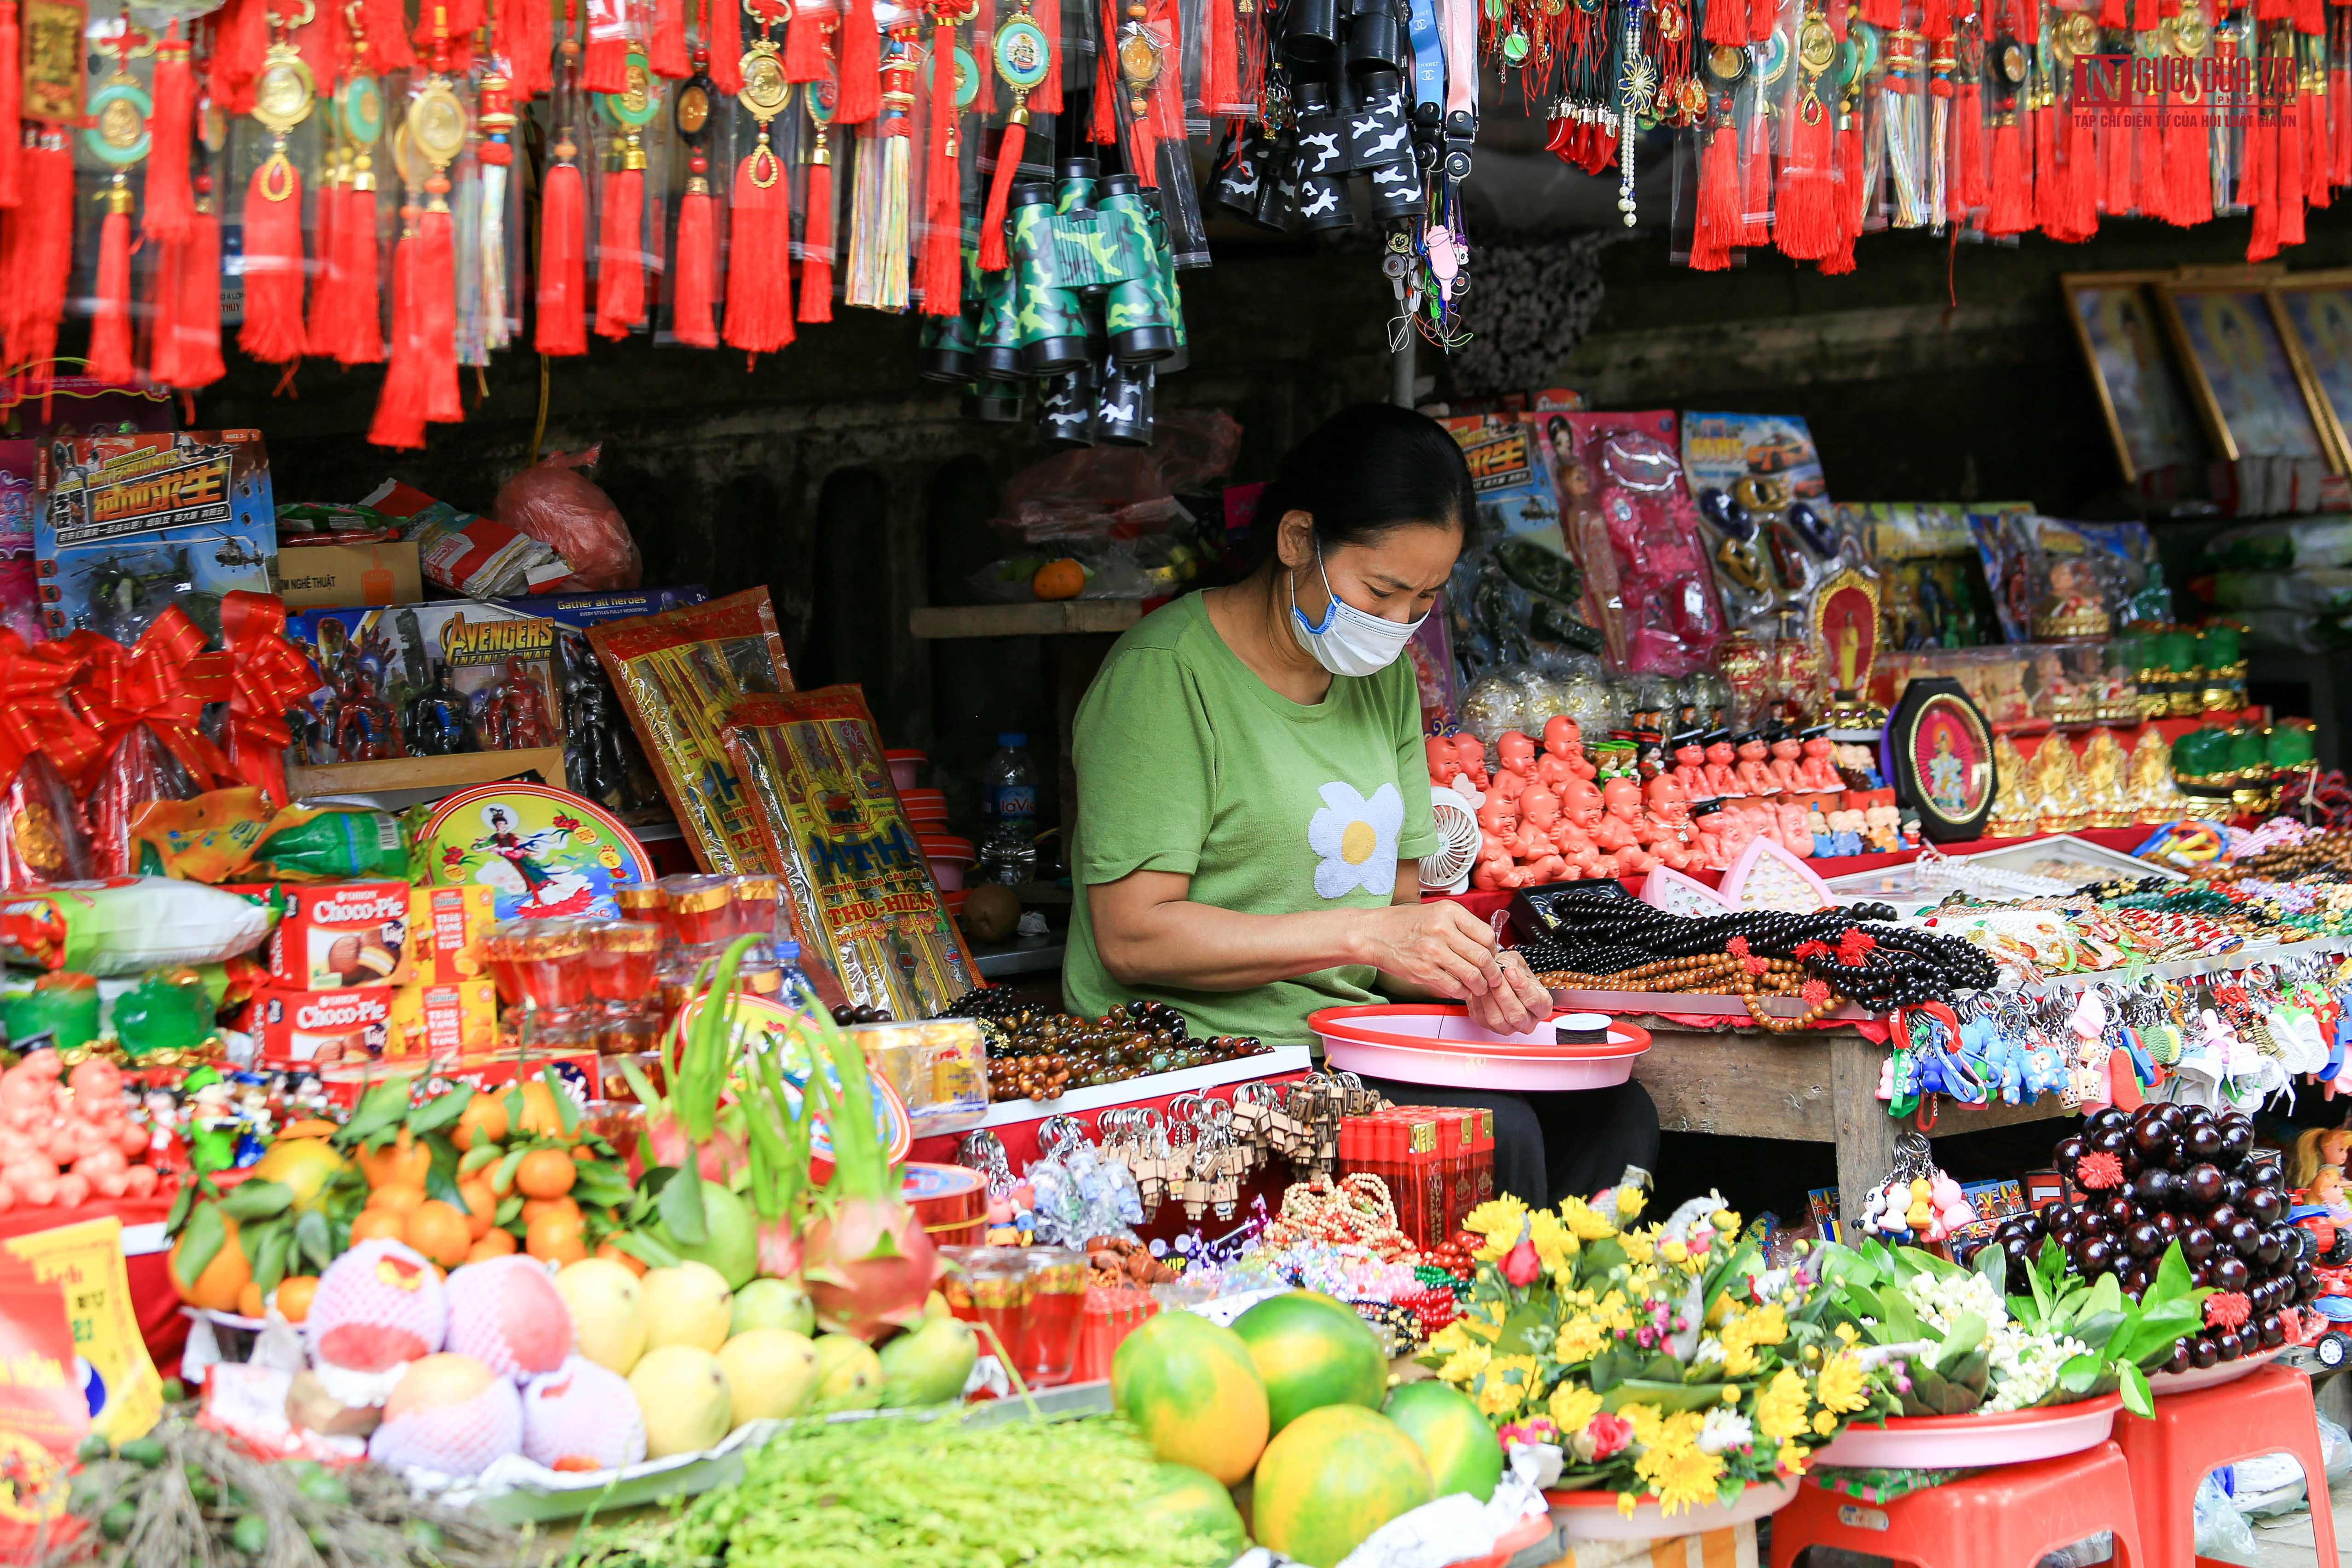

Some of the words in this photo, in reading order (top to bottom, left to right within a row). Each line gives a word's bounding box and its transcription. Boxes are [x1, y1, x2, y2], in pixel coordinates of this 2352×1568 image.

[290, 575, 311, 591] NGHỆ
[311, 574, 336, 590] THUẬT
[558, 599, 592, 610] Gather
[596, 597, 609, 607] all
[611, 596, 646, 606] heroes
[696, 592, 707, 603] 3+
[523, 650, 551, 660] WAR
[885, 871, 906, 882] CAO
[1894, 1071, 1906, 1097] YOU
[1162, 1257, 1186, 1271] VIP
